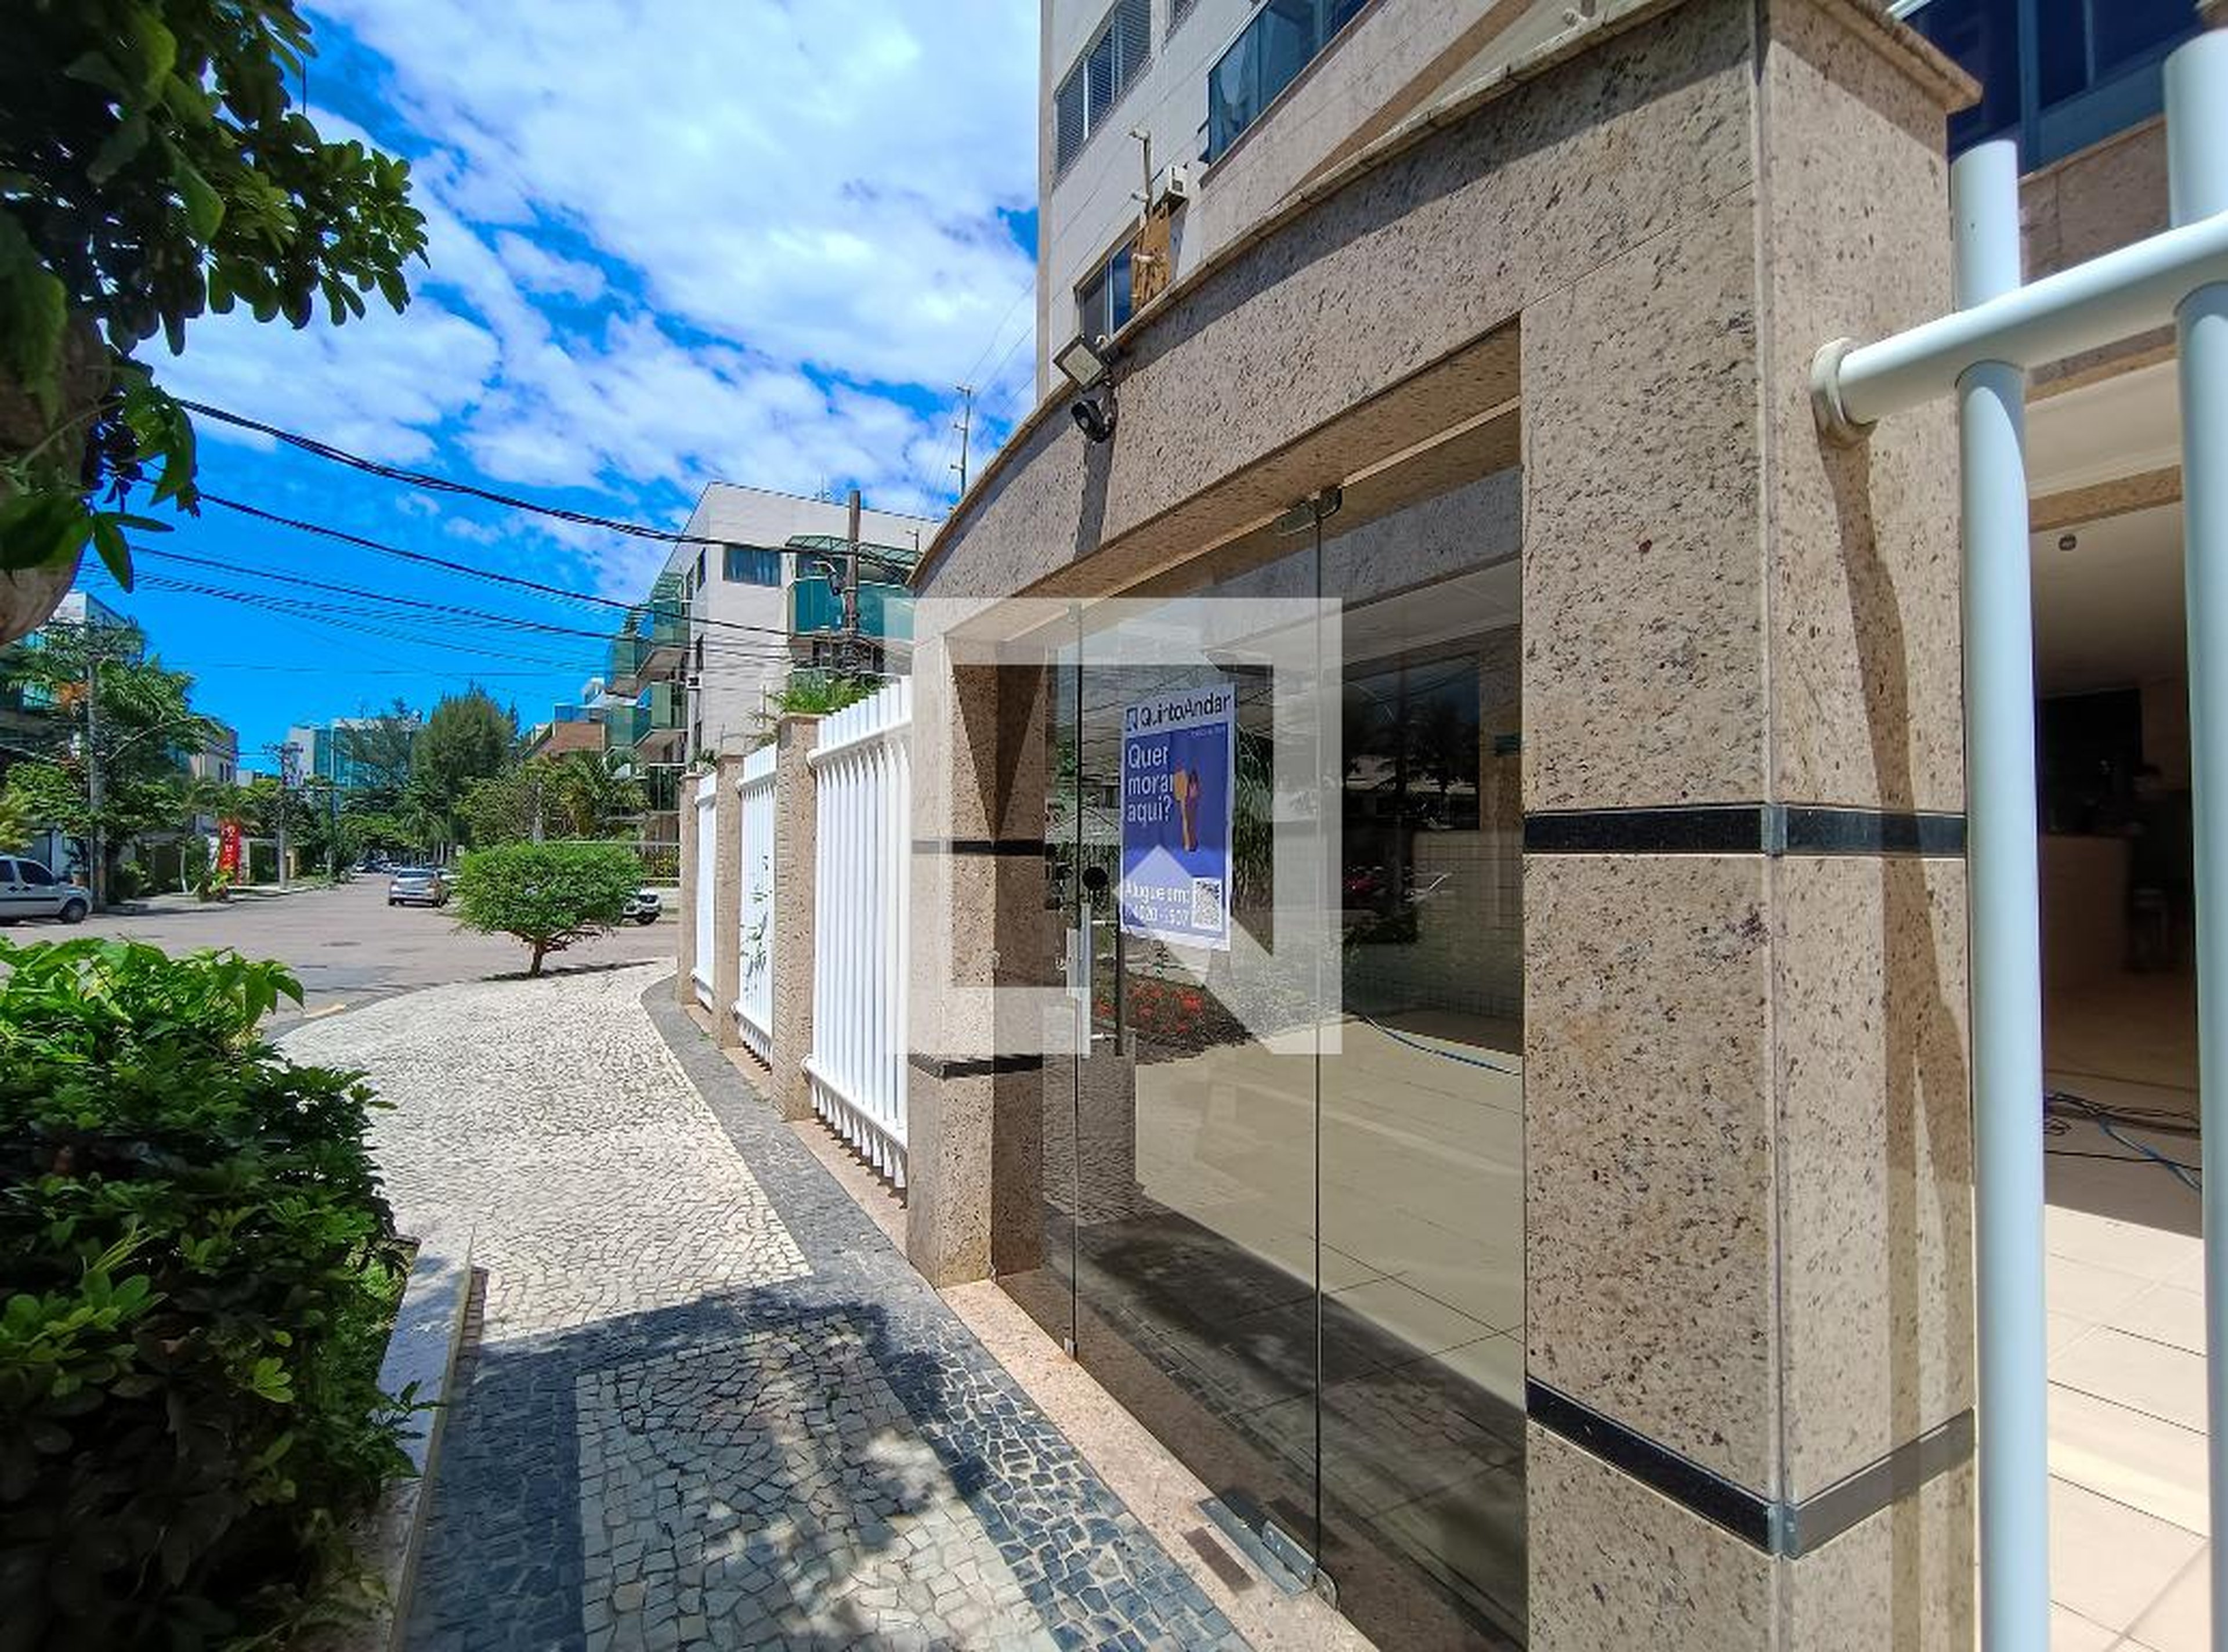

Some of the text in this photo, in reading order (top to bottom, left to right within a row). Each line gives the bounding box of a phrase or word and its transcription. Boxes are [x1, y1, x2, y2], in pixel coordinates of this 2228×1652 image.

[1140, 693, 1231, 728] QuintoAndar
[1128, 743, 1169, 769] Quer
[1127, 773, 1173, 796] morar
[1127, 795, 1171, 827] aqui?
